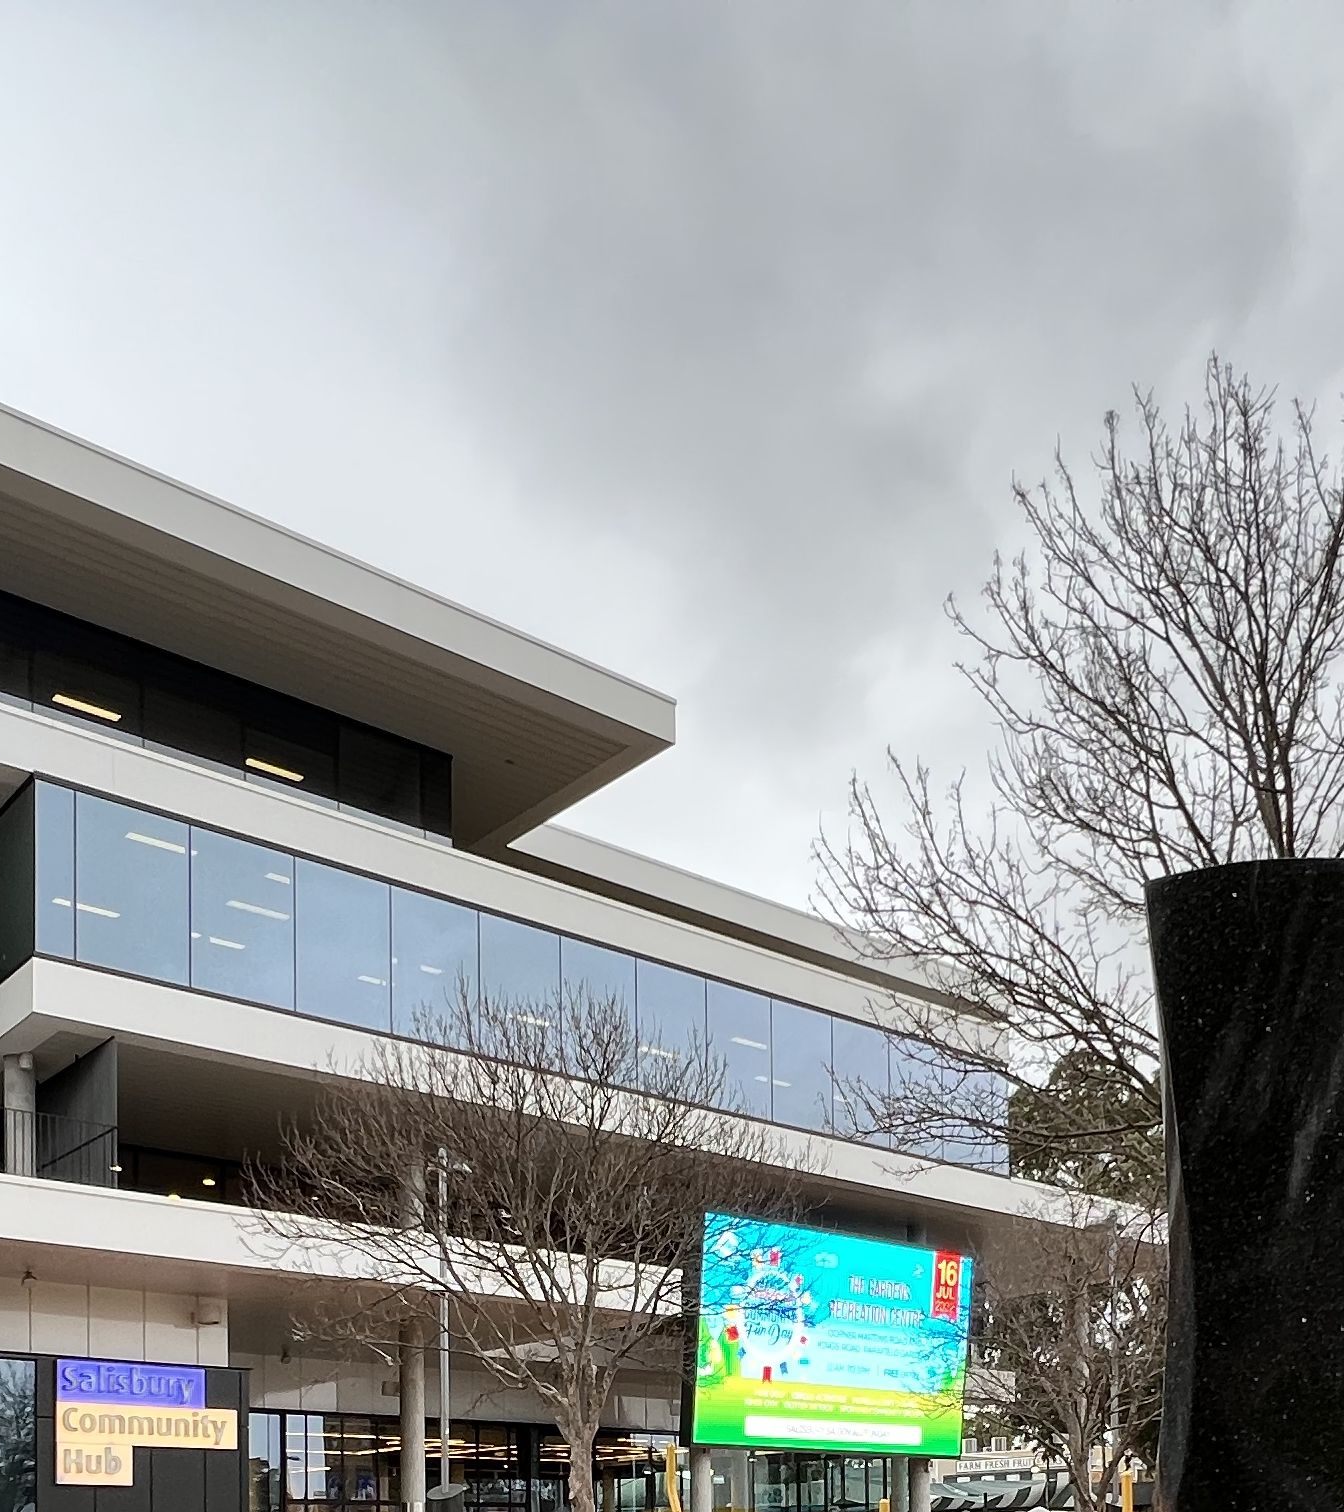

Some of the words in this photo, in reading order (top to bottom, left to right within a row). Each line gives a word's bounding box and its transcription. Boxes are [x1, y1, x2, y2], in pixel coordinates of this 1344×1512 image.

[937, 1259, 958, 1287] 16
[936, 1285, 955, 1300] JUL
[829, 1300, 887, 1324] RECREATION
[744, 1320, 766, 1339] Fun
[767, 1323, 793, 1346] Day
[60, 1364, 195, 1404] Salisbury
[61, 1406, 228, 1446] Community
[62, 1446, 123, 1476] Hub
[958, 1462, 981, 1472] FARM
[984, 1460, 1008, 1471] FRESH
